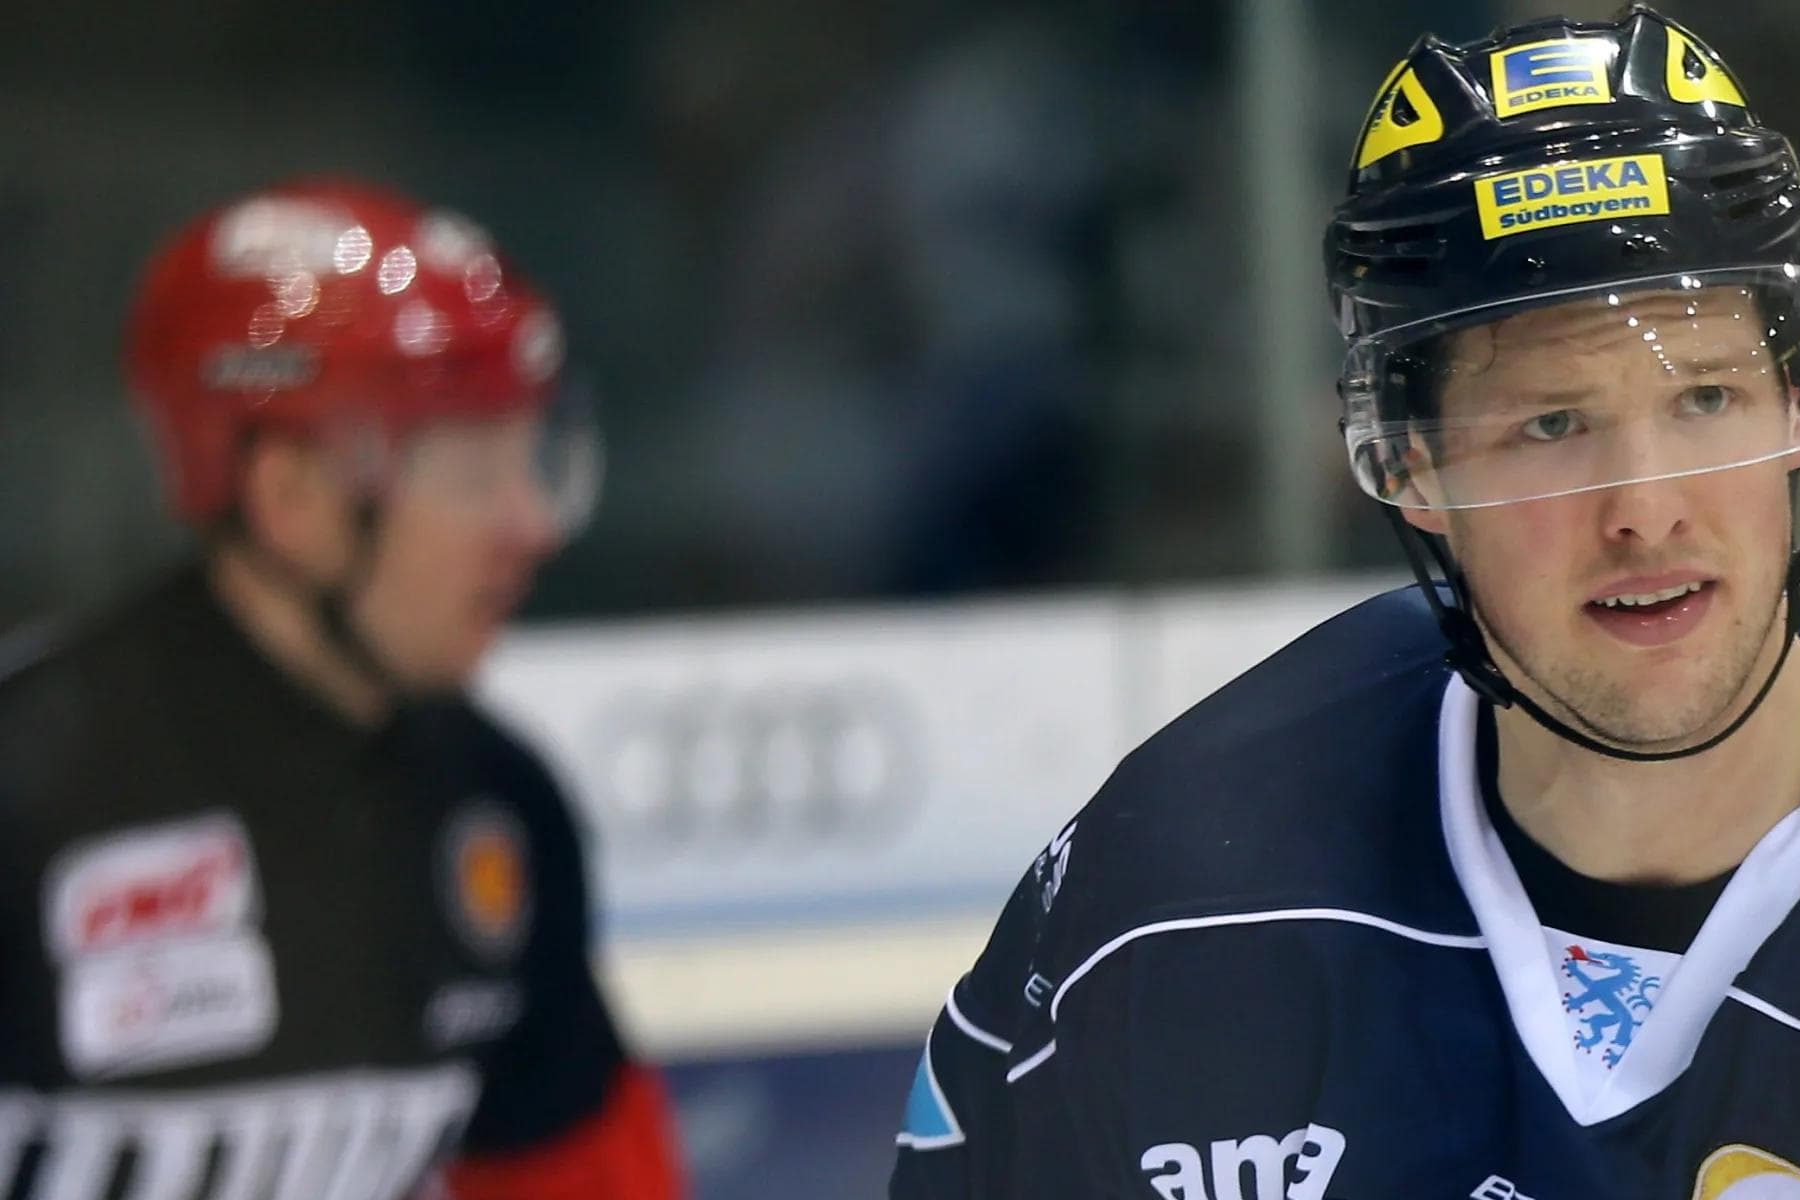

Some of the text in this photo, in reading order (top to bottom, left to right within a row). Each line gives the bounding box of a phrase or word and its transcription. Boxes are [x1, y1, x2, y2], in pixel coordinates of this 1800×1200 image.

[1507, 86, 1600, 108] EDEKA
[1492, 160, 1649, 208] EDEKA
[1499, 195, 1651, 229] Südbayern
